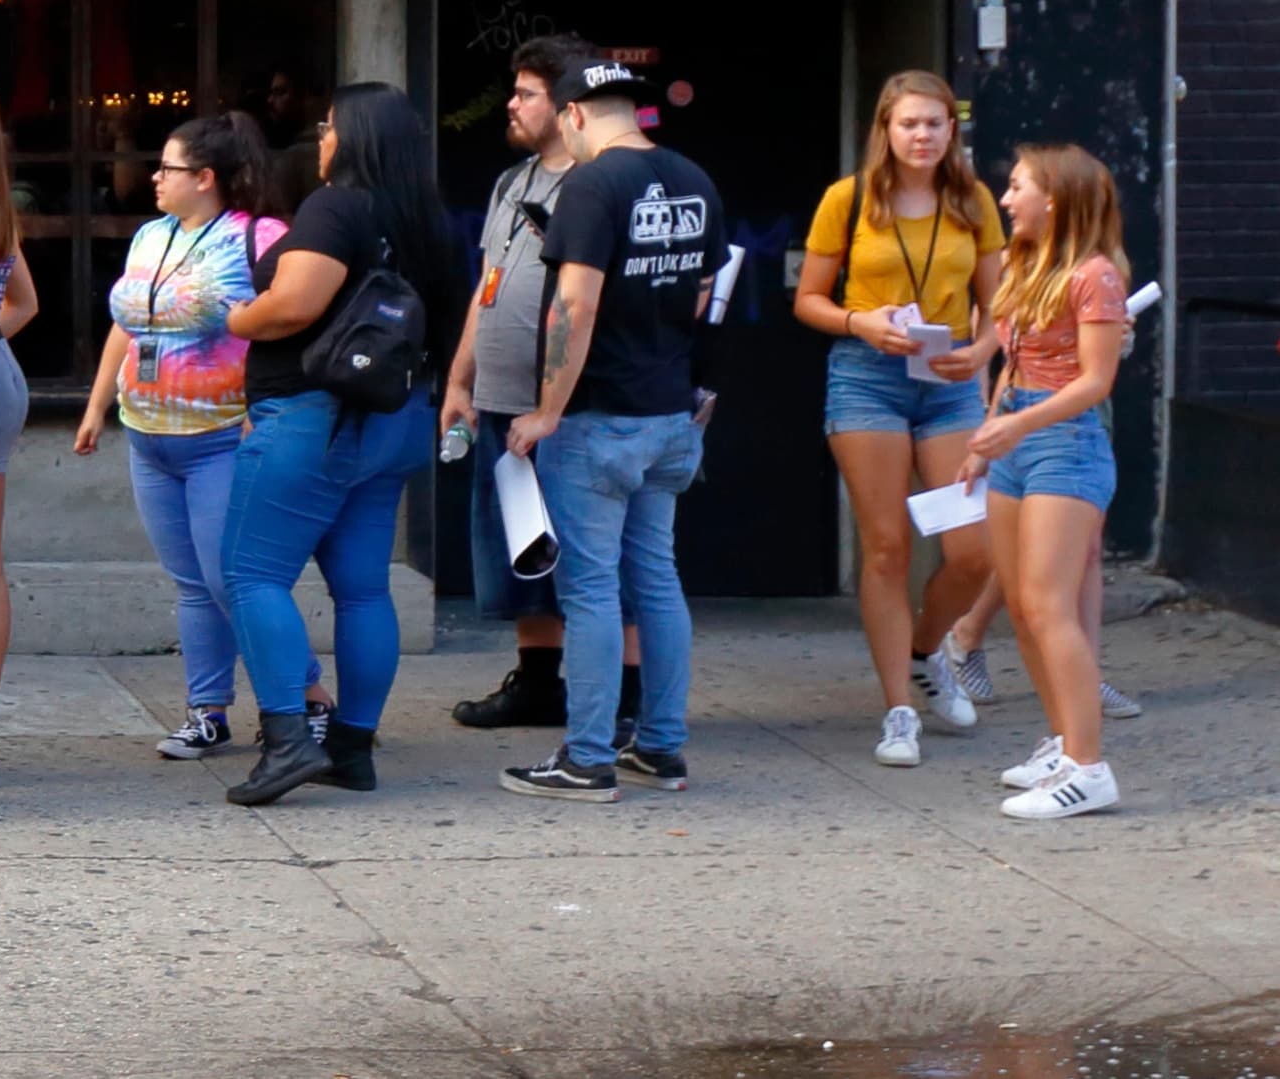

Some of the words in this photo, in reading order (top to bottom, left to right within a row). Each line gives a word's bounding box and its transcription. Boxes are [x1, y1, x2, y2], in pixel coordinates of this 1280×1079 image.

[624, 256, 657, 276] DON'T
[657, 254, 680, 274] LOK
[679, 251, 705, 271] BCK
